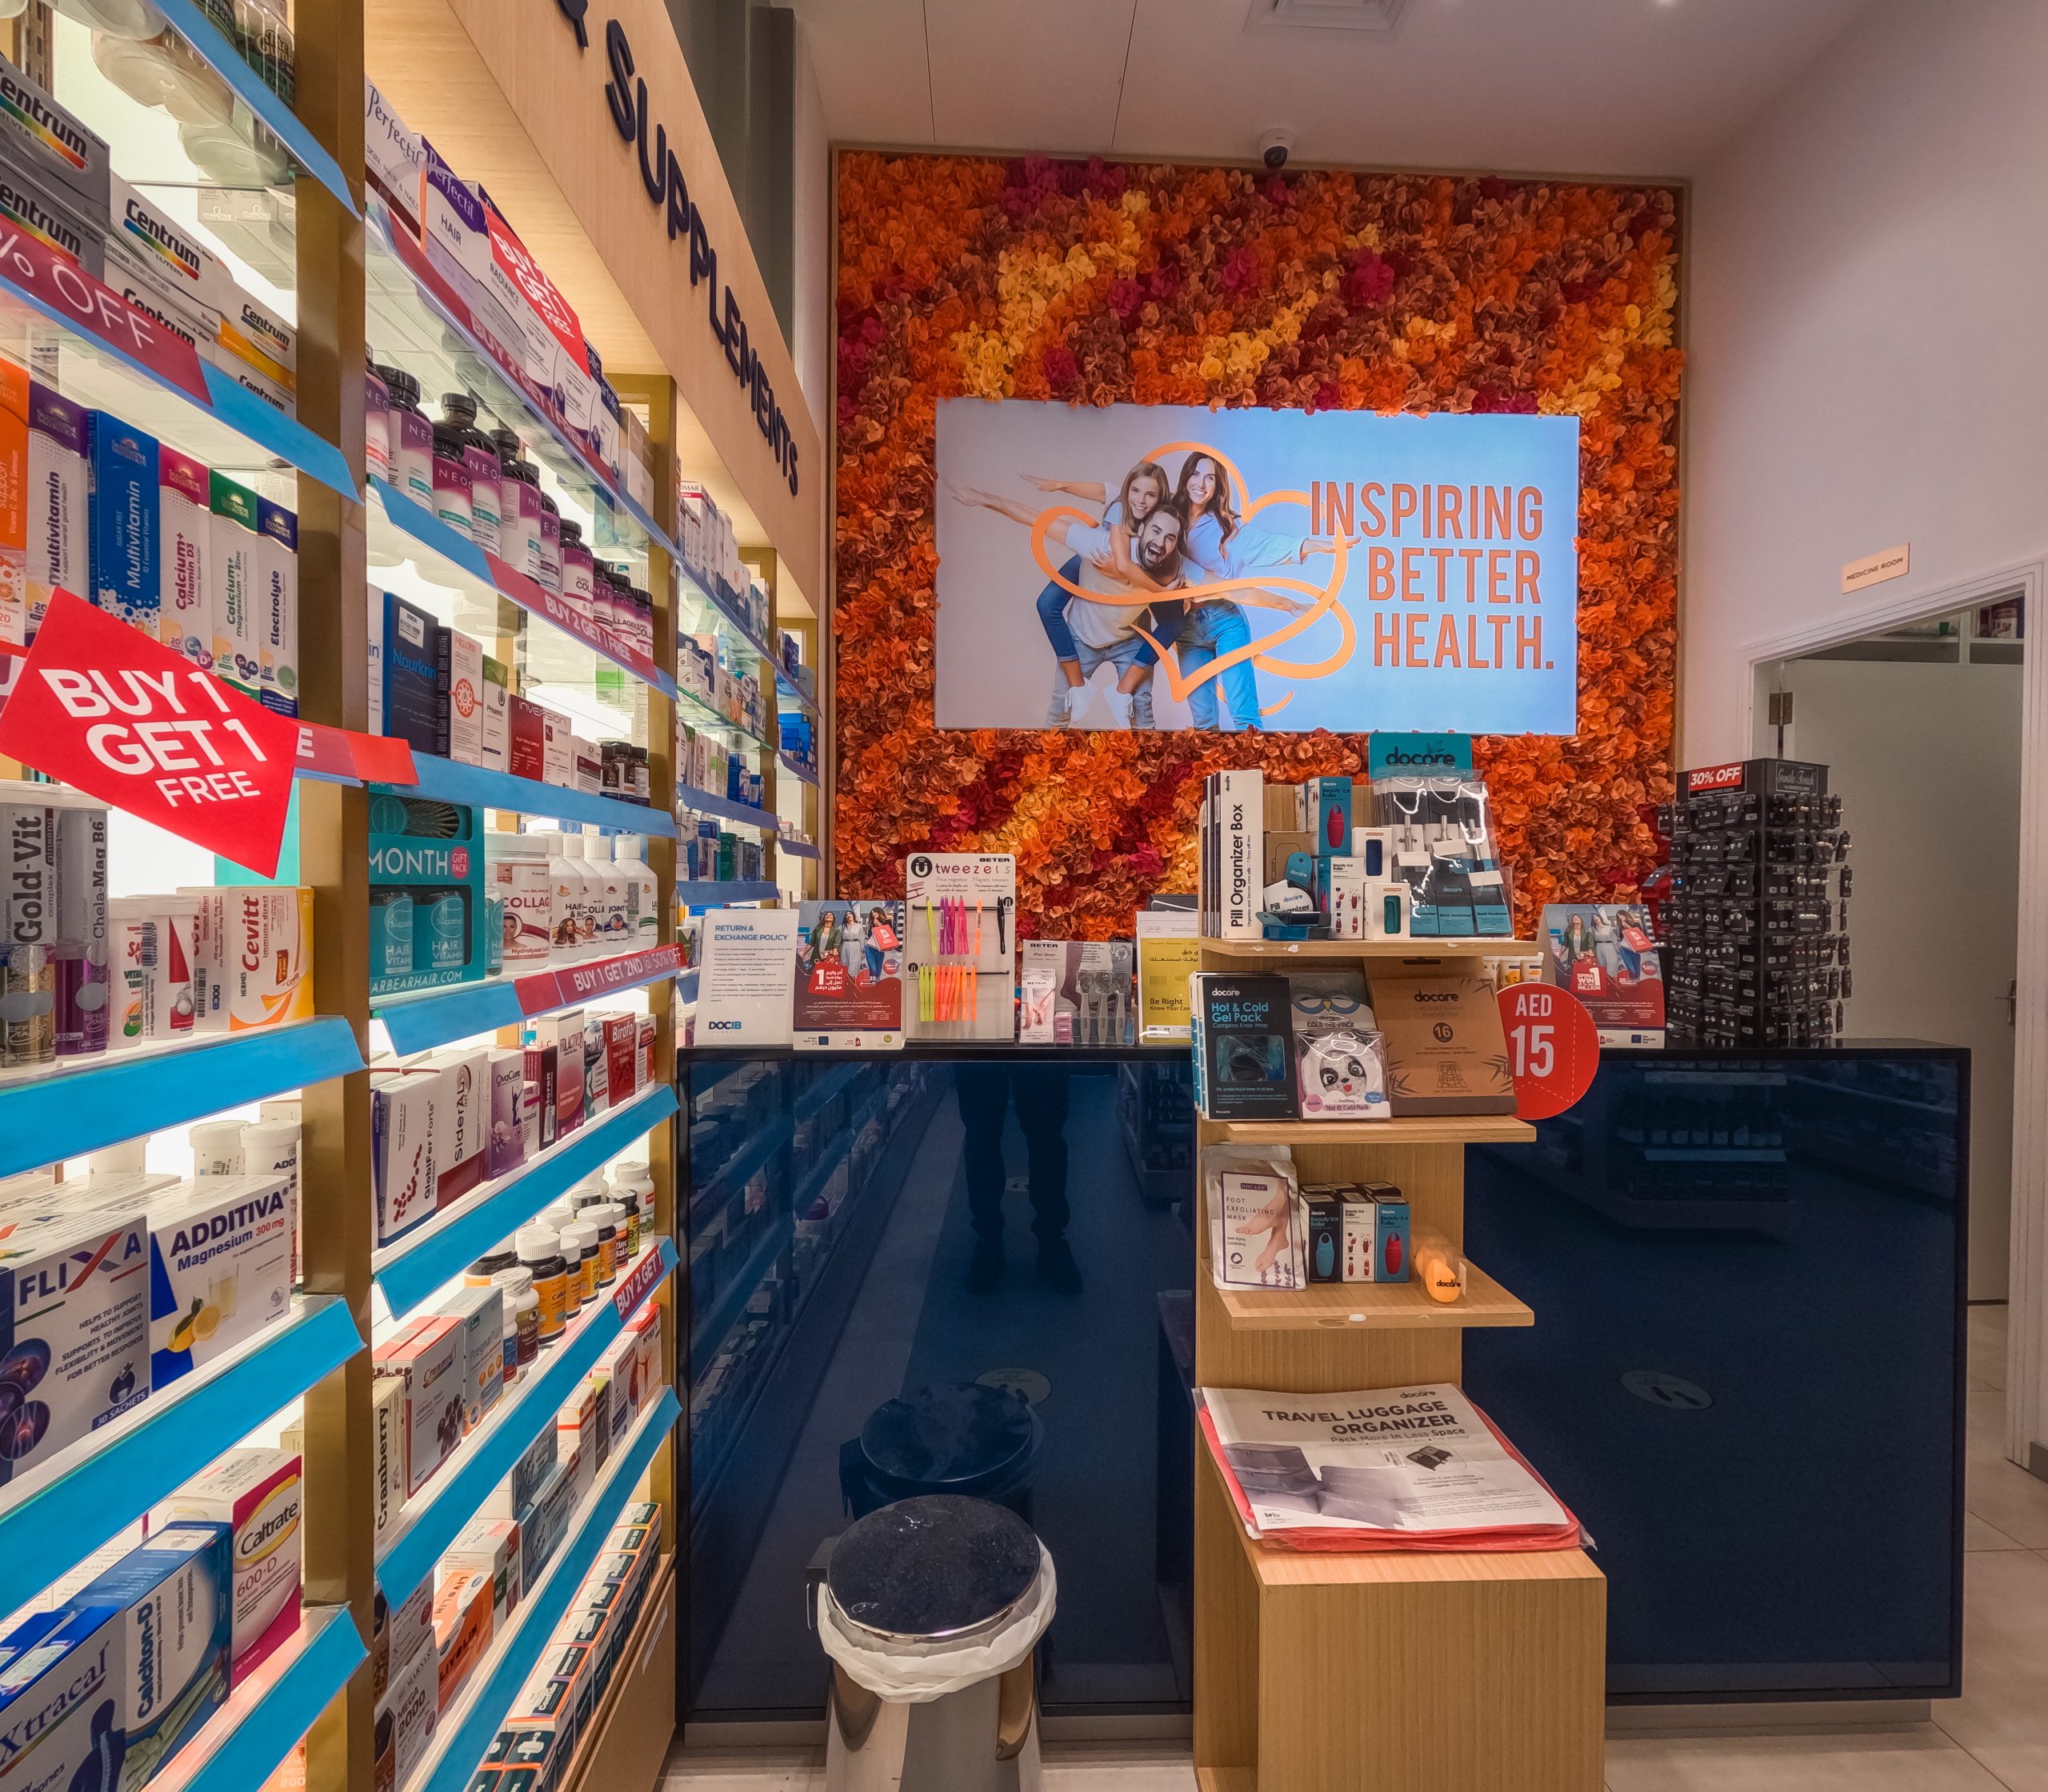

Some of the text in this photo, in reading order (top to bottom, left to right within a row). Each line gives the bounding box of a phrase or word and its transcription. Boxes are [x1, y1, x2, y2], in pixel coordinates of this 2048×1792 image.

[366, 85, 424, 168] Perfectil
[427, 147, 475, 221] Perfectil
[125, 198, 202, 274] Centrum
[441, 213, 462, 246] HAIR
[155, 253, 184, 278] LUTEIN
[605, 19, 798, 496] SUPPLEMENTS
[52, 256, 154, 350] OFF
[490, 263, 518, 306] RADIANCE
[515, 267, 559, 315] GET
[242, 304, 290, 347] Centrum
[471, 321, 506, 361] BUY
[542, 307, 575, 338] FREE
[46, 471, 61, 586] multivitamin
[1310, 481, 1542, 540] INSPIRING
[126, 480, 141, 589] Multivitamin
[187, 543, 194, 558] D3
[174, 532, 186, 610] Calcium+
[1369, 547, 1541, 604] BETTER
[1846, 557, 1903, 582] MEDICINE ROOM
[270, 570, 282, 646] Electrolyte
[545, 594, 632, 662] BUY 2 GET FREE
[1374, 613, 1554, 670] HEALTH.
[393, 648, 436, 680] Nourkrin
[38, 668, 189, 718] BUY
[187, 671, 231, 713] 1
[85, 718, 268, 775] GET 1
[1386, 746, 1455, 766] docare
[154, 770, 262, 807] FREE
[1690, 766, 1742, 786] 30% OFF
[451, 863, 467, 873] PACK
[452, 853, 467, 864] GIFT
[1230, 804, 1246, 927] Pill Organizer Box
[1290, 869, 1307, 878] docare
[13, 816, 42, 942] Gold-Vit
[92, 821, 106, 938] Chela-Mag B6
[1283, 894, 1303, 903] docare
[1270, 902, 1280, 910] Pill
[242, 895, 259, 971] Cevitt
[432, 940, 458, 951] HAIR
[511, 947, 541, 955] Hydrolyzed
[573, 947, 682, 992] BUY 1 GET 2ND 50% OFF
[1162, 998, 1182, 1007] Right
[1211, 1002, 1269, 1012] Hot & Cold
[1212, 988, 1240, 996] docare
[1414, 990, 1459, 1002] docare
[1515, 994, 1552, 1016] AED
[613, 1021, 634, 1042] Birofol
[708, 1022, 742, 1030] DOCIB
[1212, 1013, 1262, 1022] Gel Pack
[1434, 1026, 1450, 1038] 16
[1510, 1025, 1554, 1078] 15
[426, 1103, 434, 1138] Forte
[169, 1191, 284, 1258] ADDITIVA
[1226, 1206, 1274, 1215] EXFOLIATING
[178, 1230, 253, 1272] Magnesium
[255, 1223, 271, 1237] 300
[272, 1217, 285, 1231] mg
[19, 1230, 142, 1306] FLIXA
[616, 1258, 658, 1317] BUY 2 GET
[1436, 1278, 1461, 1289] docare
[79, 1292, 142, 1330] HELPS SUPPORT
[90, 1314, 121, 1334] HEALTHY
[55, 1322, 143, 1375] FLEXIBILITY MOVEMENT
[62, 1314, 142, 1362] SUPPORTS IMPROVE
[66, 1334, 143, 1382] FOR BETTER RESPONSE
[97, 1391, 146, 1427] 30 SACHETS
[1262, 1401, 1449, 1422] TRAVEL LUGGAGE
[1399, 1390, 1436, 1399] docare
[1331, 1414, 1458, 1435] ORGANIZER
[1360, 1434, 1389, 1442] More
[1404, 1430, 1430, 1439] Less
[1431, 1428, 1466, 1437] Space
[377, 1406, 389, 1532] Cranberry
[241, 1502, 298, 1555] Caltrate
[137, 1602, 153, 1720] Calciton-D
[0, 1647, 107, 1766] Xtracal
[398, 1686, 419, 1715] MEGA
[398, 1690, 426, 1738] 2000
